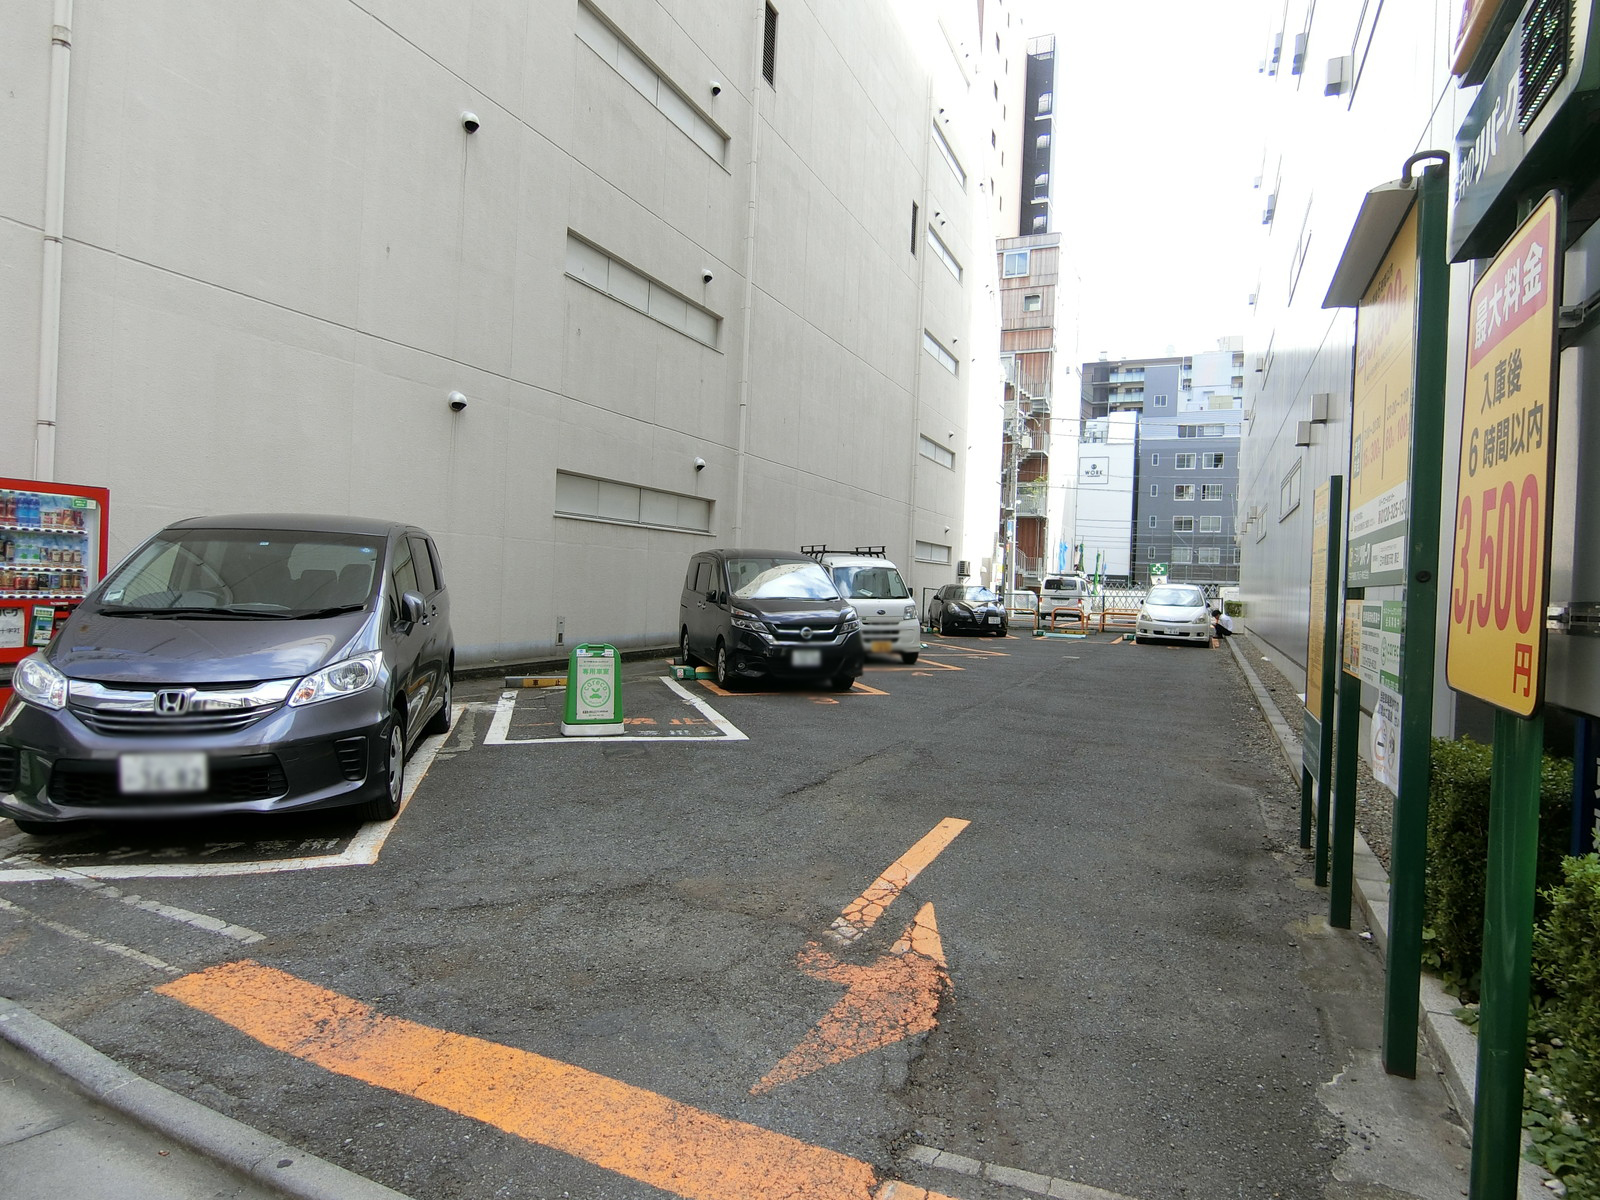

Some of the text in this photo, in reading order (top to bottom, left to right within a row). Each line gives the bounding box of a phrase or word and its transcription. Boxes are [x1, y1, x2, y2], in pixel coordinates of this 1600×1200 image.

[1474, 242, 1543, 350] 最大料金
[1481, 348, 1523, 415] 入庫後
[1468, 400, 1544, 478] 6時間以内
[1454, 472, 1539, 698] 3,500 円
[584, 680, 608, 692] careco
